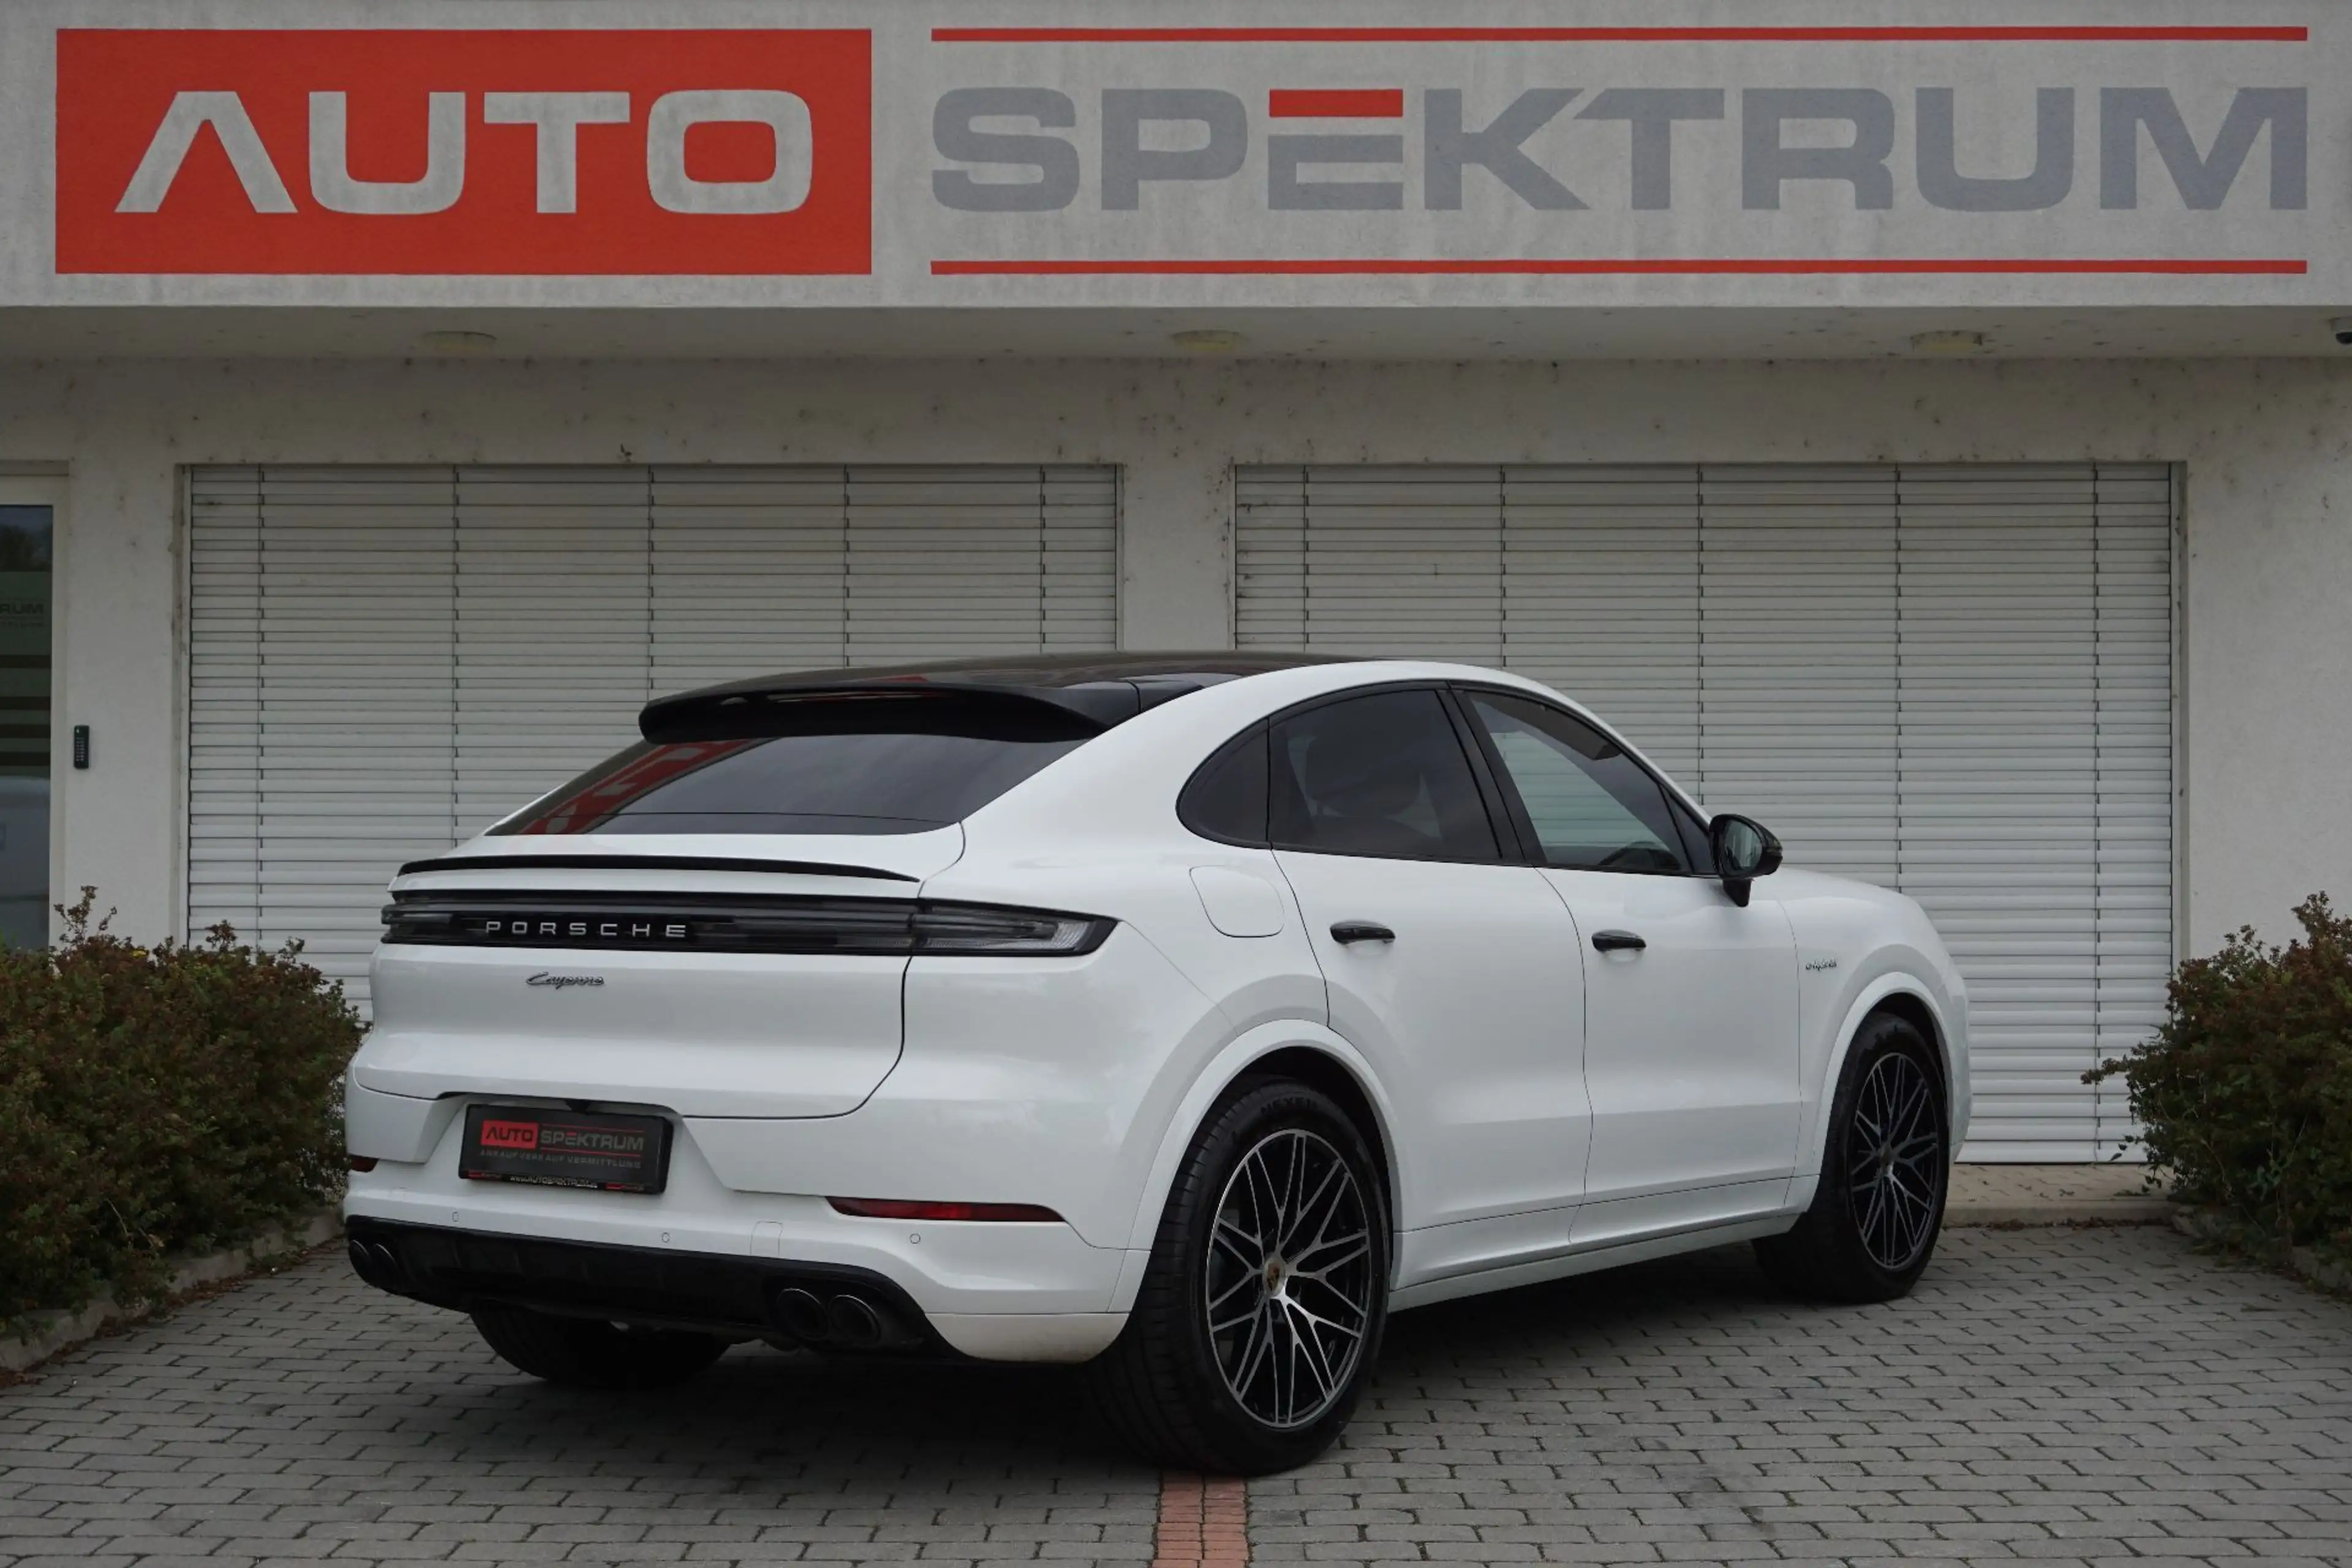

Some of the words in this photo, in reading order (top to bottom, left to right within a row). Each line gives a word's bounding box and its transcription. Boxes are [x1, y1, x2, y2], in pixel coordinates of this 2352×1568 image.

[114, 89, 813, 215] AUTO
[932, 87, 2307, 212] SPEKTRUM
[485, 921, 687, 938] PORSCHE
[526, 971, 605, 990] Cayenne
[485, 1125, 535, 1143] AUTO
[540, 1129, 644, 1151] SPEKTRUM
